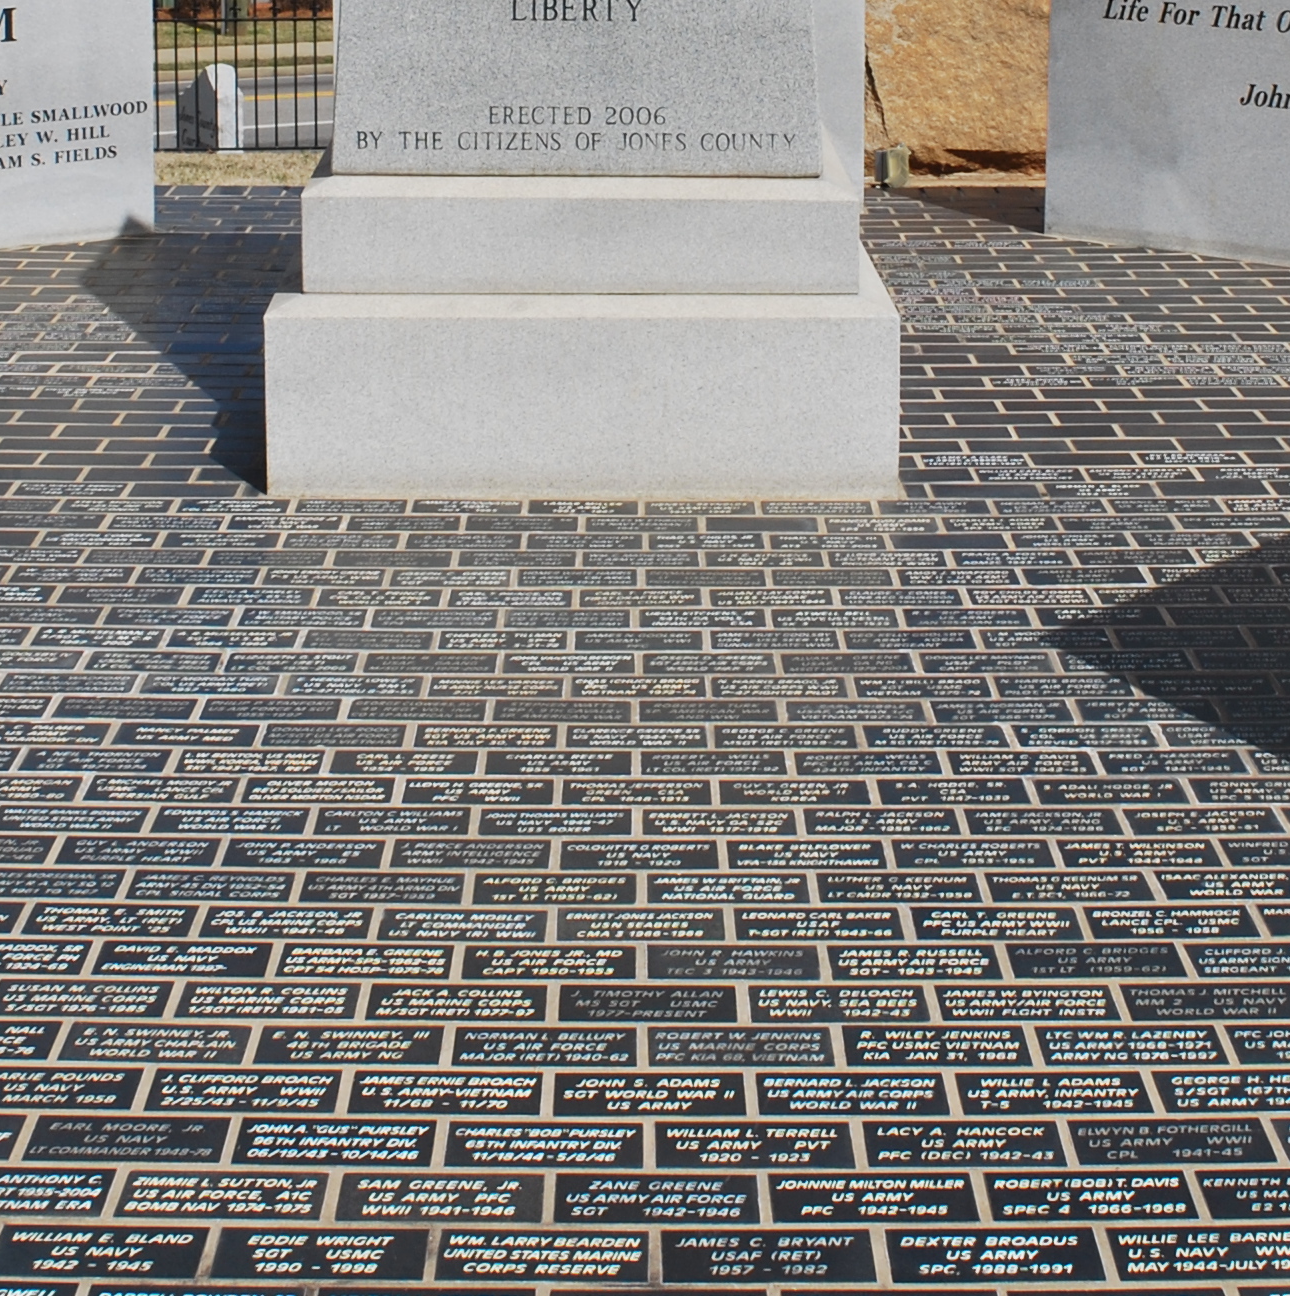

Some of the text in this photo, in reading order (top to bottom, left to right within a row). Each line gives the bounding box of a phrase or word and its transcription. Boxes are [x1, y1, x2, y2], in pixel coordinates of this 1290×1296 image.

[1159, 1, 1201, 26] For
[1211, 5, 1266, 31] That
[31, 101, 148, 123] SMALLWOOD
[489, 106, 665, 125] ERECTED 2006
[36, 130, 58, 143] W.
[67, 125, 110, 142] HILL
[357, 131, 795, 151] BY THE CITIZENS OF JONES COUNTY
[31, 153, 45, 166] S.
[55, 145, 117, 164] FIELDS
[12, 1232, 194, 1244] WILLIAM E. BLAND
[248, 1235, 394, 1246] EDDIE WRIGHT
[900, 1236, 1077, 1247] DEXTER BROADUS
[51, 1246, 143, 1257] US NAVY
[252, 1248, 385, 1260] SGT USMC
[946, 1250, 1038, 1261] US ARMY
[33, 1259, 79, 1270] 1942
[107, 1260, 153, 1271] 1945
[255, 1262, 302, 1273] 1990
[331, 1263, 378, 1273] 1998
[919, 1264, 1073, 1275] SPC. 1988-1991
